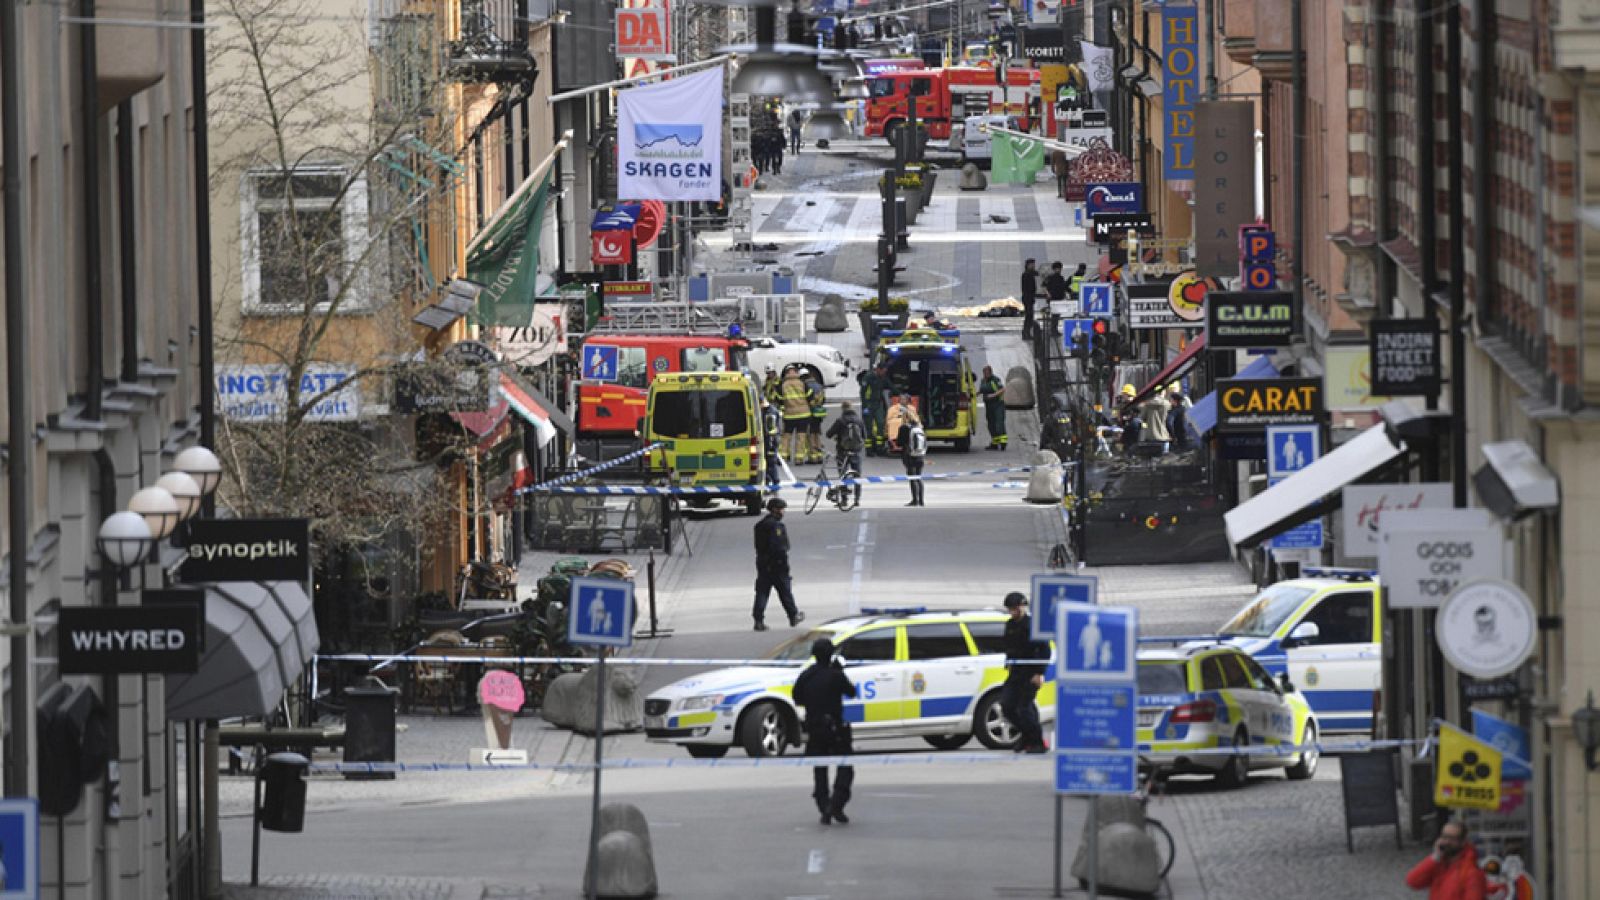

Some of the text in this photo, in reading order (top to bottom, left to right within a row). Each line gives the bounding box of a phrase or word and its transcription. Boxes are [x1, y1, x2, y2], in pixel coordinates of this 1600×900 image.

[1167, 17, 1195, 170] HOTEL
[625, 161, 712, 178] SKAGEN
[1378, 333, 1433, 348] INDIAN
[1378, 350, 1432, 366] STREET
[1223, 387, 1317, 412] CARAT
[190, 540, 298, 560] synoptik
[1417, 542, 1473, 559] GODIS
[1430, 562, 1461, 575] OCH
[1418, 579, 1459, 596] TOB
[72, 629, 186, 650] WHYRED
[1456, 785, 1495, 800] TRISS
